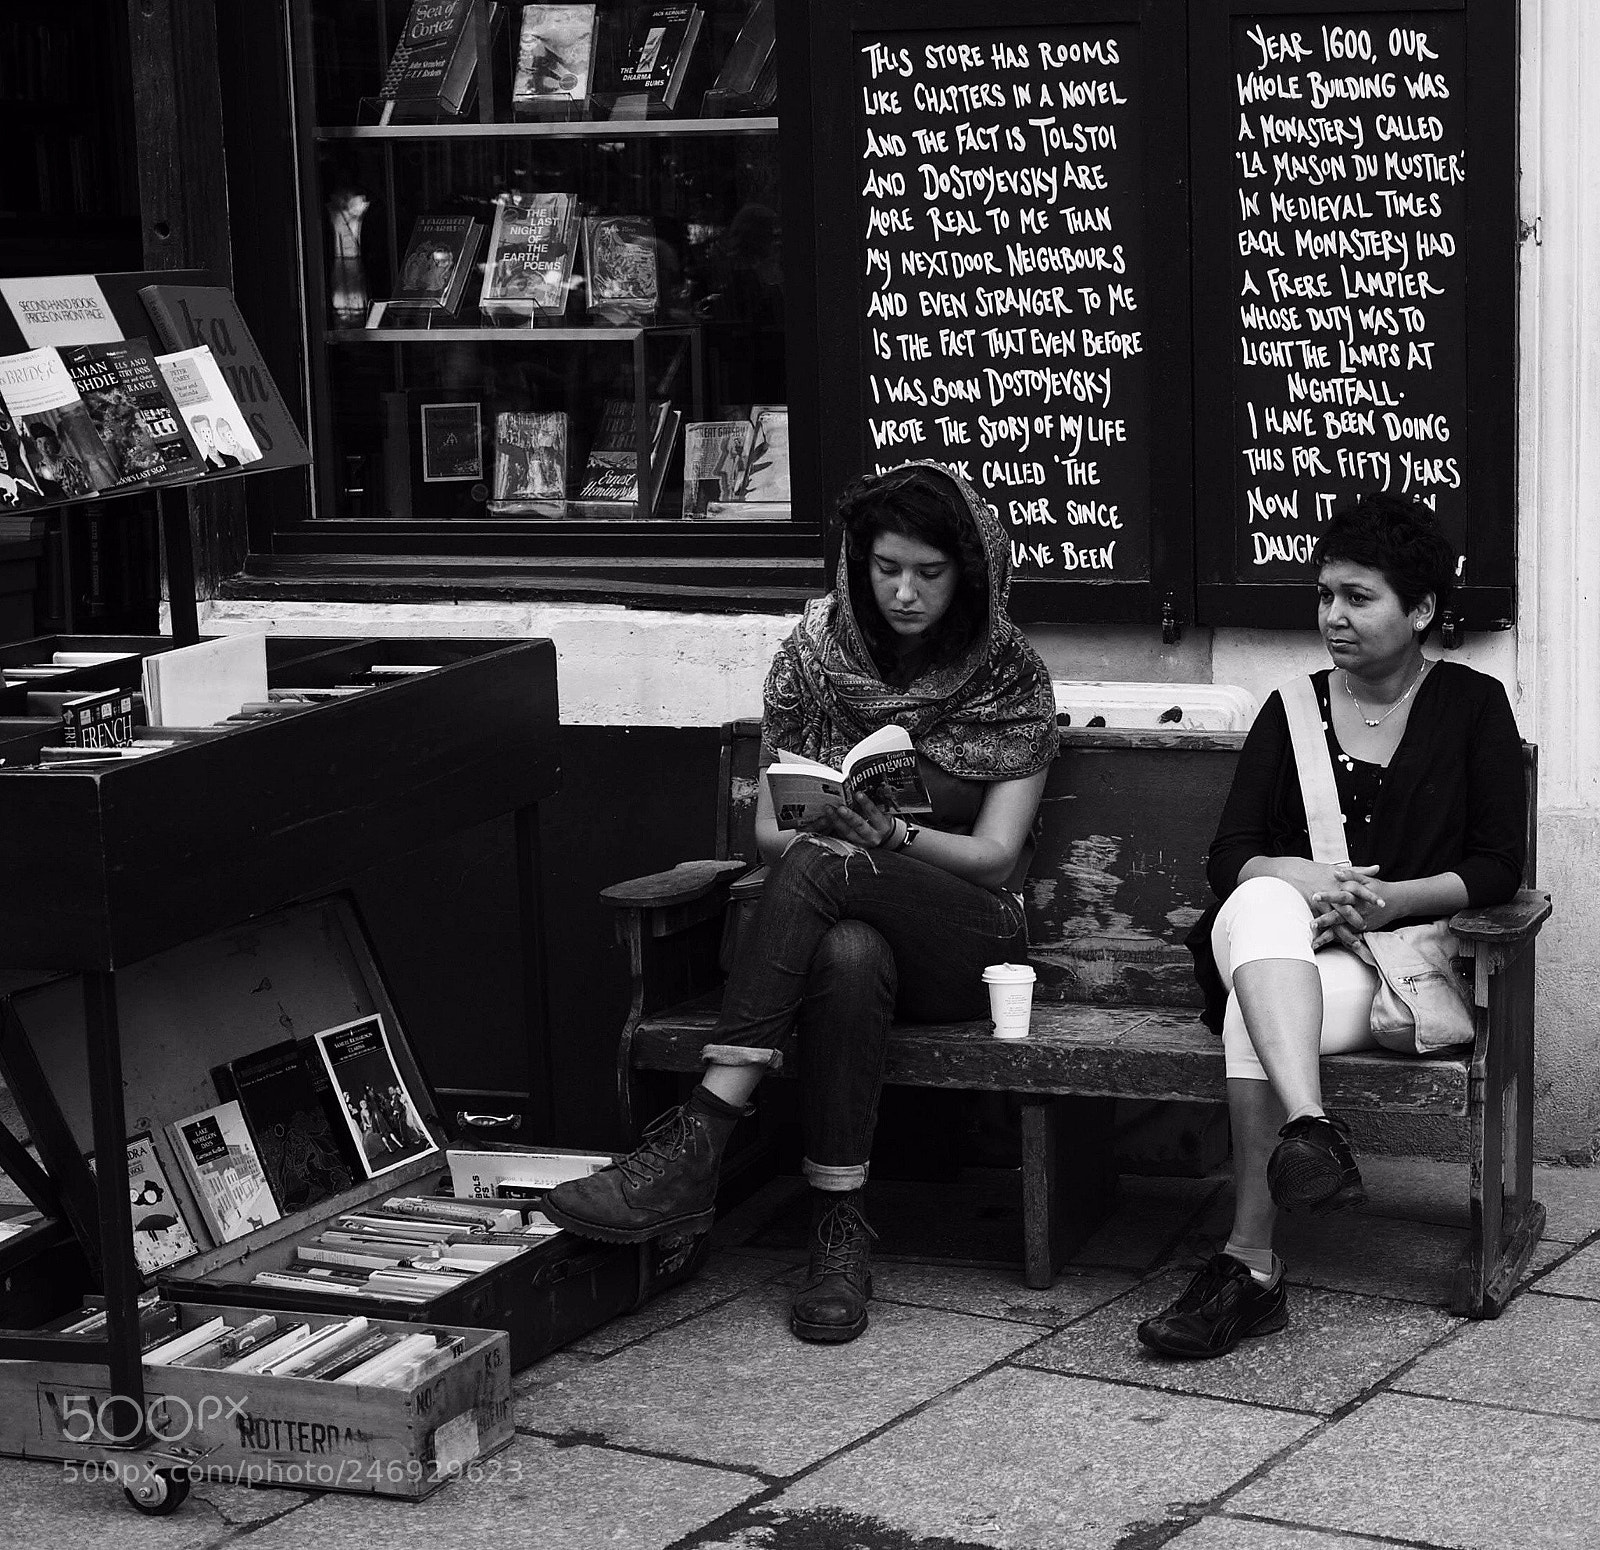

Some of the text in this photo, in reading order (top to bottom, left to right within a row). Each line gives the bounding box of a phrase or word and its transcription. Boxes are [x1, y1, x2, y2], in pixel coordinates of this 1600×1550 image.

[861, 39, 1119, 79] THIS STORE HAS ROOMS
[1247, 24, 1438, 70] YEAR 1600, OUR
[864, 80, 1127, 115] LIKE CHAPTERS IN A NOVEL
[1237, 72, 1449, 109] WHOLE BUILDING WAS
[863, 117, 1116, 158] AND THE FACT IS TOLSTOI
[1239, 113, 1443, 149] A MONASTERY CALLED
[862, 161, 1107, 205] AND DOSTOYEVSKY ARE
[1273, 152, 1346, 185] MAISON
[1351, 155, 1378, 181] DU
[526, 209, 547, 218] THE
[530, 218, 559, 226] LAST
[1239, 188, 1441, 223] IN MEDIEVAL TIMES
[510, 227, 543, 235] NIGHT
[527, 236, 543, 244] OF
[866, 206, 1111, 241] MORE REAL TO ME THAN
[502, 253, 540, 262] EARTH
[527, 244, 549, 253] THE
[1239, 229, 1455, 271] EACH MONASTERY HAD
[523, 262, 561, 271] POEMS
[866, 243, 1125, 290] MY NEXT DOOR NEIGHBOURS
[1241, 265, 1445, 302] A FRERE LAMPIER
[71, 298, 97, 309] BOOKS
[867, 284, 1137, 320] AND EVEN STRANGER TO ME
[1241, 303, 1425, 345] WHOSE DUTY WAS TO
[873, 328, 1143, 361] IS THE FACT THAT EVEN BEFORE
[1241, 337, 1434, 373] LIGHT THE LAMPS AT
[5, 360, 57, 384] BRIDGE
[70, 361, 108, 379] LMAN
[113, 358, 147, 370] ELS AND
[74, 373, 119, 392] SHDIE
[127, 380, 158, 392] RANCE
[870, 367, 1110, 408] I WAS BORN DOSTOYEVSKY
[869, 415, 1126, 457] WROTE THE STORY OF MY LIFE
[1247, 402, 1449, 441] I HAVE BEEN DOING
[136, 468, 152, 480] LAST
[151, 464, 167, 475] SIGH
[598, 470, 636, 486] Ernest
[983, 461, 1045, 489] CALLED
[1242, 446, 1460, 493] THIS FOR FIFTY YEARS
[1009, 498, 1057, 525] EVER
[1067, 500, 1123, 529] SINCE
[1247, 487, 1336, 524] NOW IT
[1061, 541, 1116, 570] BEEN
[82, 715, 133, 748] FRENCH
[472, 1175, 483, 1199] BOLS
[482, 1187, 490, 1199] FS
